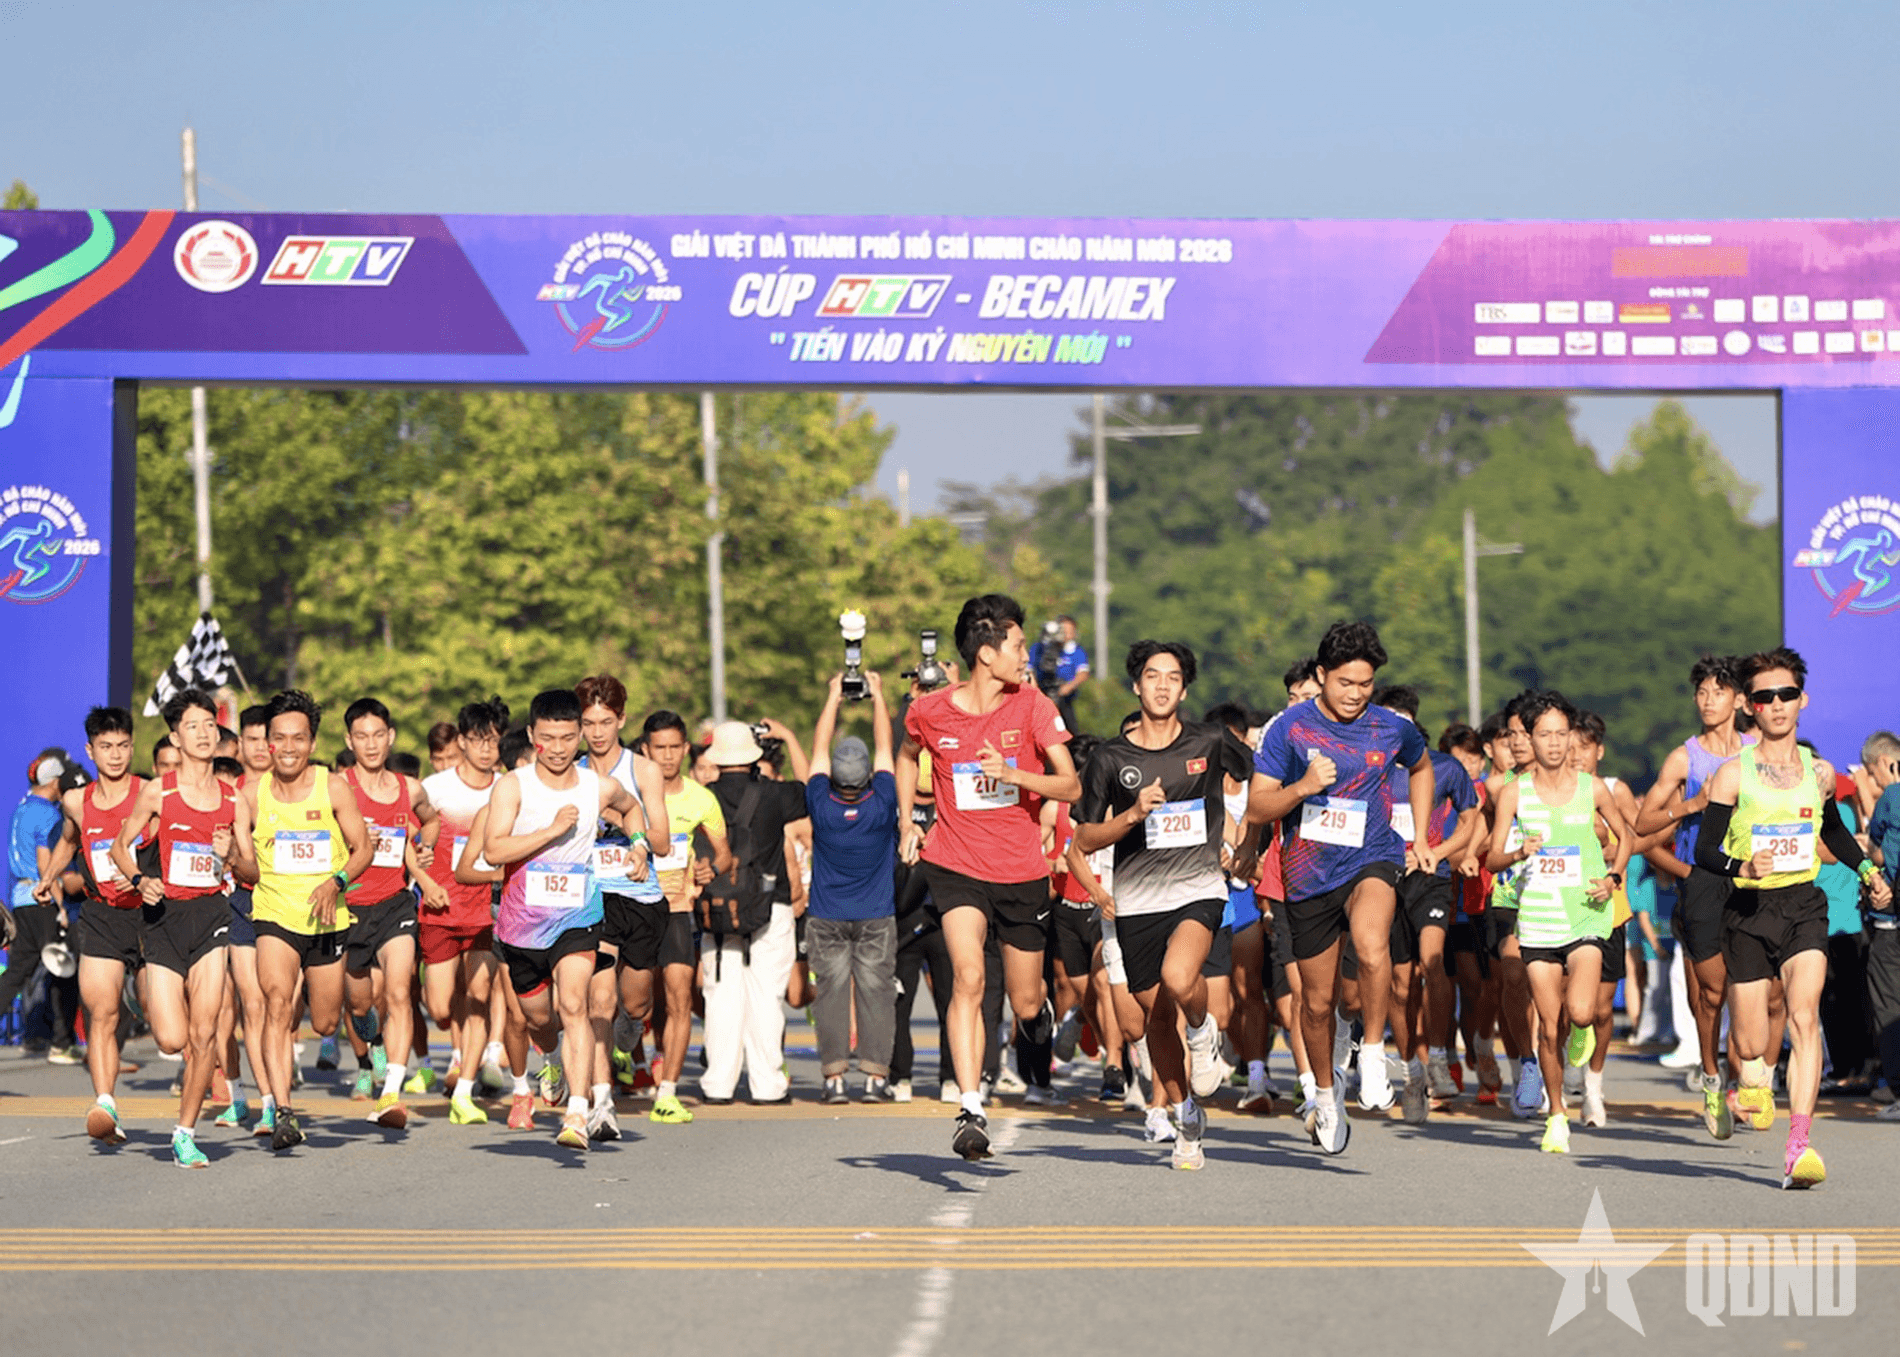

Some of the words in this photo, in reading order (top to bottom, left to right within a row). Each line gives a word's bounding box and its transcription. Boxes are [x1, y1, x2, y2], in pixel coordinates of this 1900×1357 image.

[713, 231, 756, 262] VIỆT
[791, 232, 857, 259] THÀNH
[860, 230, 901, 259] PHỐ
[936, 232, 969, 260] CHÍ
[972, 236, 1026, 260] MINH
[1029, 233, 1083, 260] CHÀO
[1179, 238, 1233, 262] 2026
[268, 241, 408, 280] HTV
[645, 285, 682, 301] 2026
[729, 264, 816, 317] CÚP
[978, 274, 1176, 320] BECAMEX
[789, 325, 848, 362] TIẾN
[850, 328, 904, 362] VÀO
[945, 330, 1053, 363] NGUYÊN
[1053, 331, 1110, 363] MỚI
[63, 539, 101, 555] 2026
[1163, 814, 1191, 833] 220
[1320, 810, 1347, 830] 219
[291, 843, 315, 859] 153
[598, 848, 622, 865] 154
[1769, 837, 1799, 857] 236
[190, 855, 213, 873] 168
[1539, 858, 1565, 874] 229
[544, 874, 569, 893] 152
